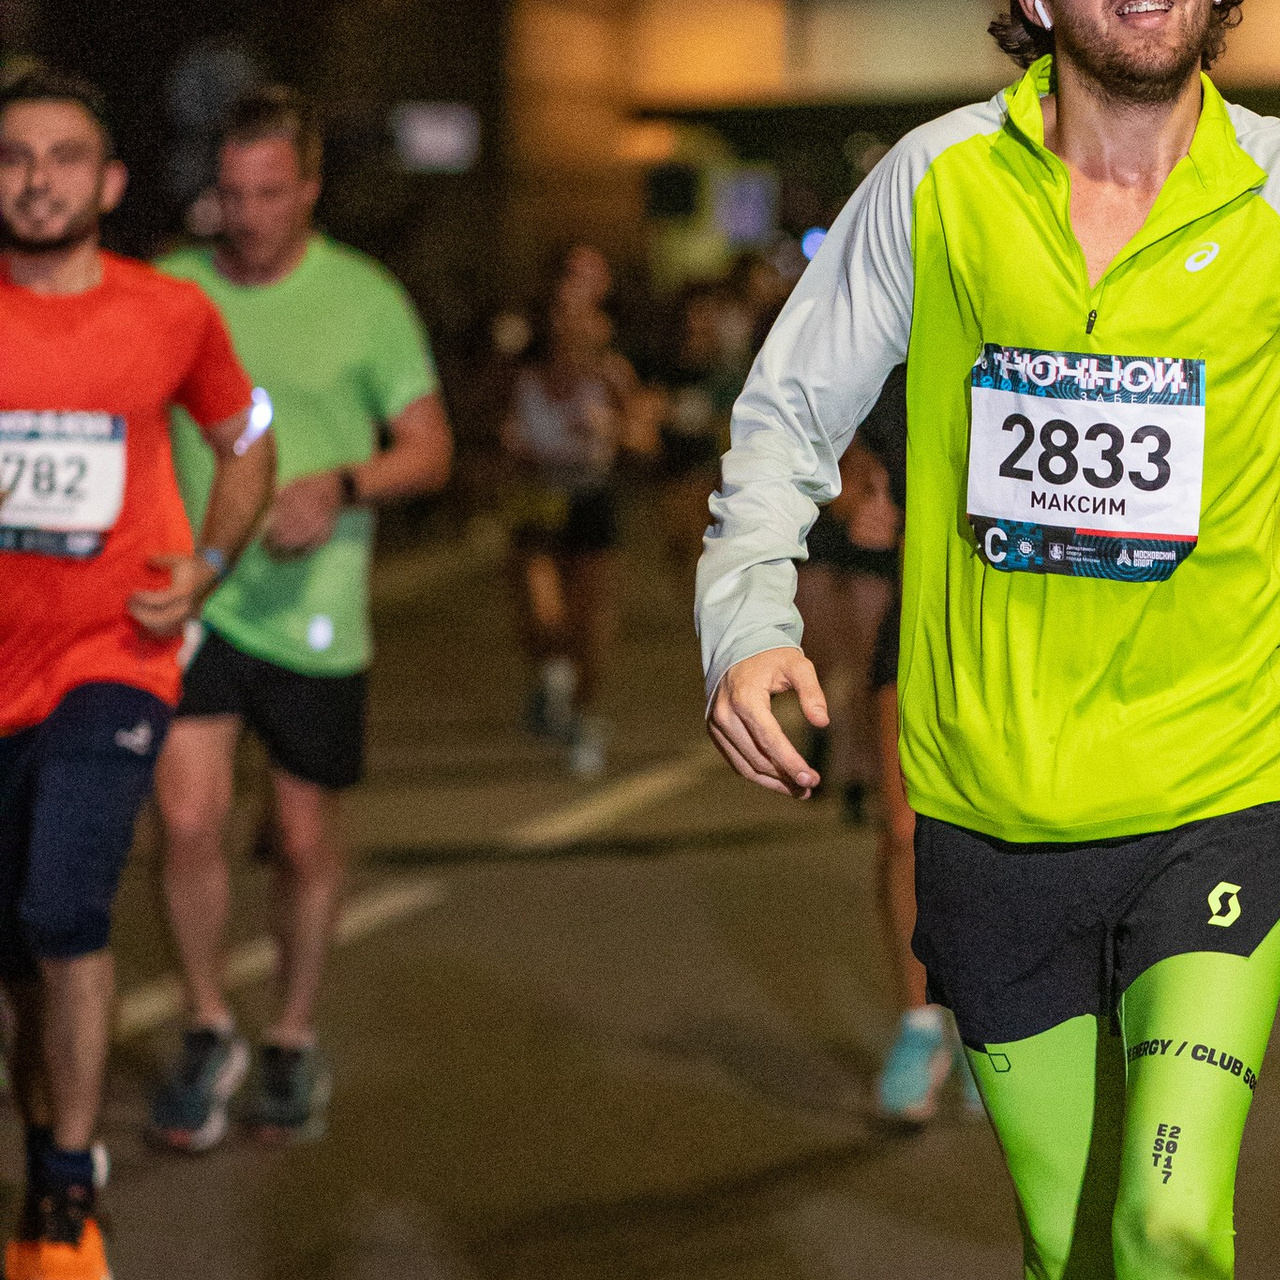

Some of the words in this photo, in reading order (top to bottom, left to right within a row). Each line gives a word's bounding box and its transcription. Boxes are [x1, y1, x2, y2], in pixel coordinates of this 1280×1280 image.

[999, 413, 1172, 492] 2833
[1031, 491, 1126, 516] МАКСИМ
[1133, 549, 1176, 561] МОСКОВСКИЙ
[1133, 559, 1153, 568] СПОРТ
[1191, 1044, 1243, 1077] CLUB
